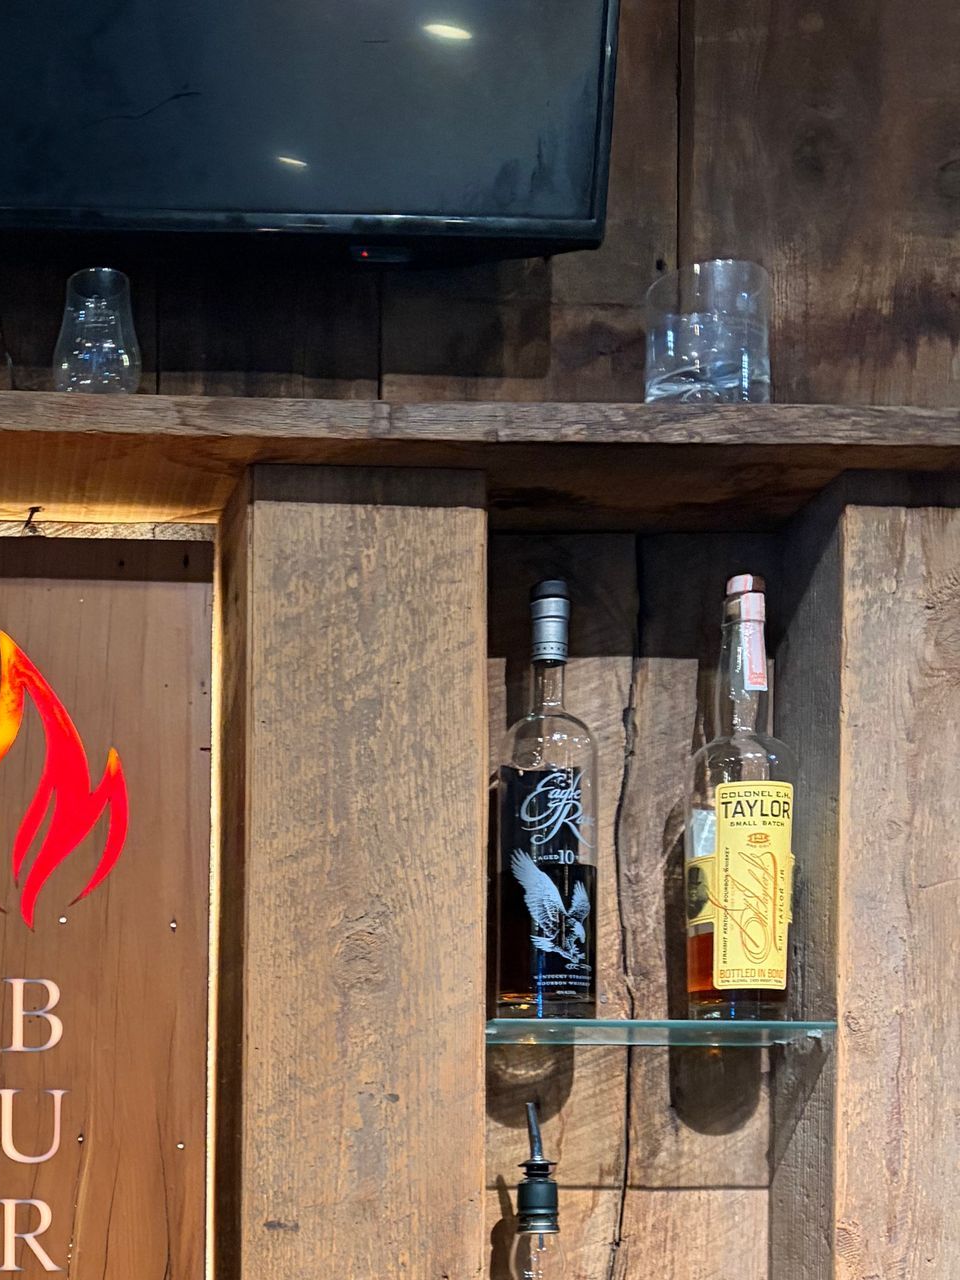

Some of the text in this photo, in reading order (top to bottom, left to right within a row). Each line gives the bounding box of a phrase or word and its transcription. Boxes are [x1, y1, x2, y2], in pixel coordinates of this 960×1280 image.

[521, 768, 586, 830] Eagle
[721, 791, 773, 799] COLONEL
[721, 800, 790, 819] TAYLOR
[558, 850, 574, 864] 10
[719, 969, 756, 979] BOTTLED
[758, 968, 766, 978] IN
